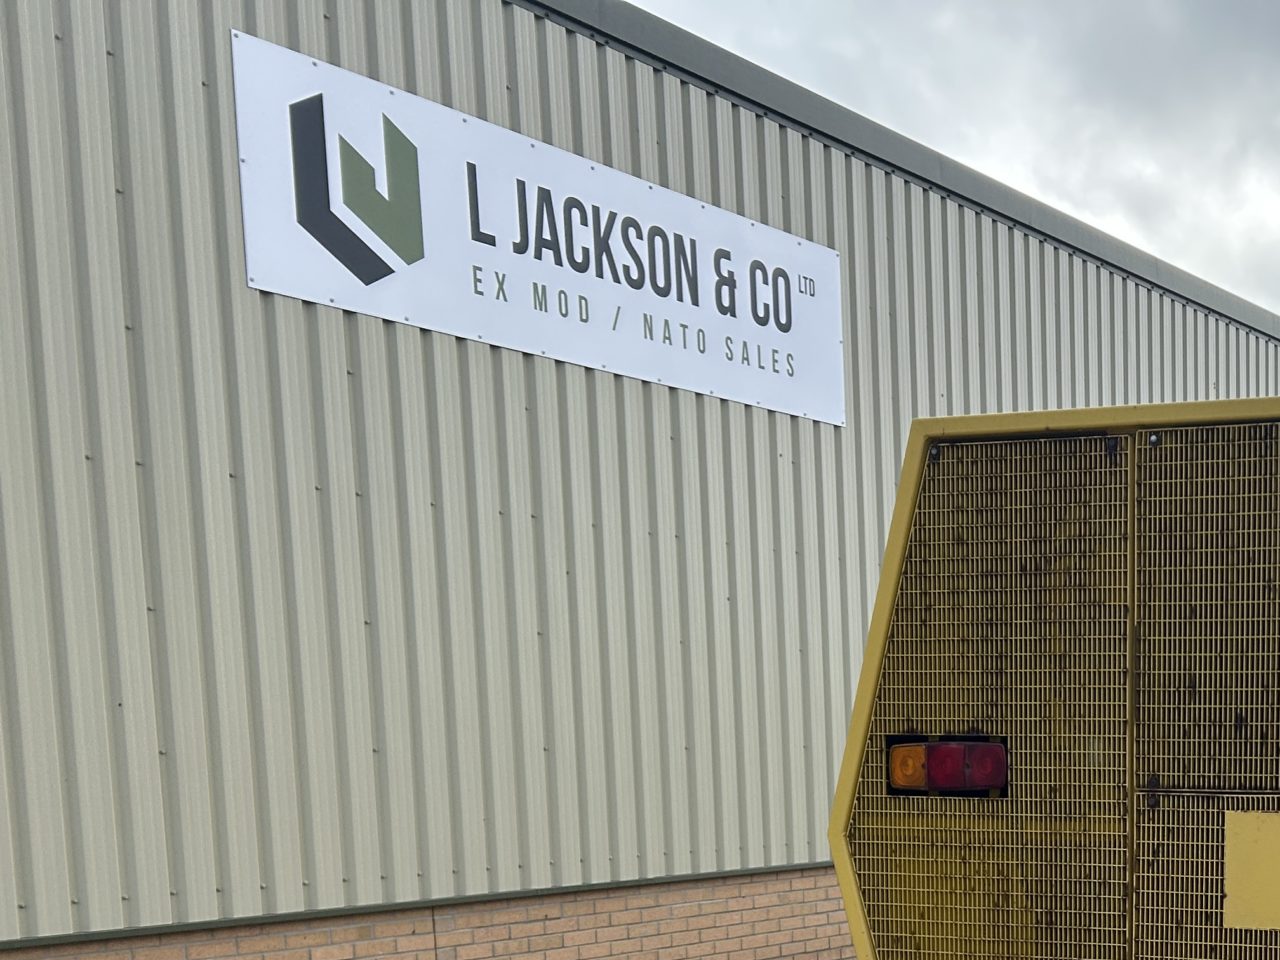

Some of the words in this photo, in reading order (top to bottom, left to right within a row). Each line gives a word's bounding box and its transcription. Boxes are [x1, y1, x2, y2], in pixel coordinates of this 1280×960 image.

[466, 161, 497, 247] L
[512, 178, 700, 308] JACKSON
[713, 248, 738, 319] &
[749, 259, 793, 334] CO
[798, 274, 816, 298] LTD
[472, 265, 508, 302] EX
[532, 281, 590, 324] MOD
[612, 306, 621, 331] /
[643, 312, 706, 354] NATO
[725, 336, 795, 378] SALES
